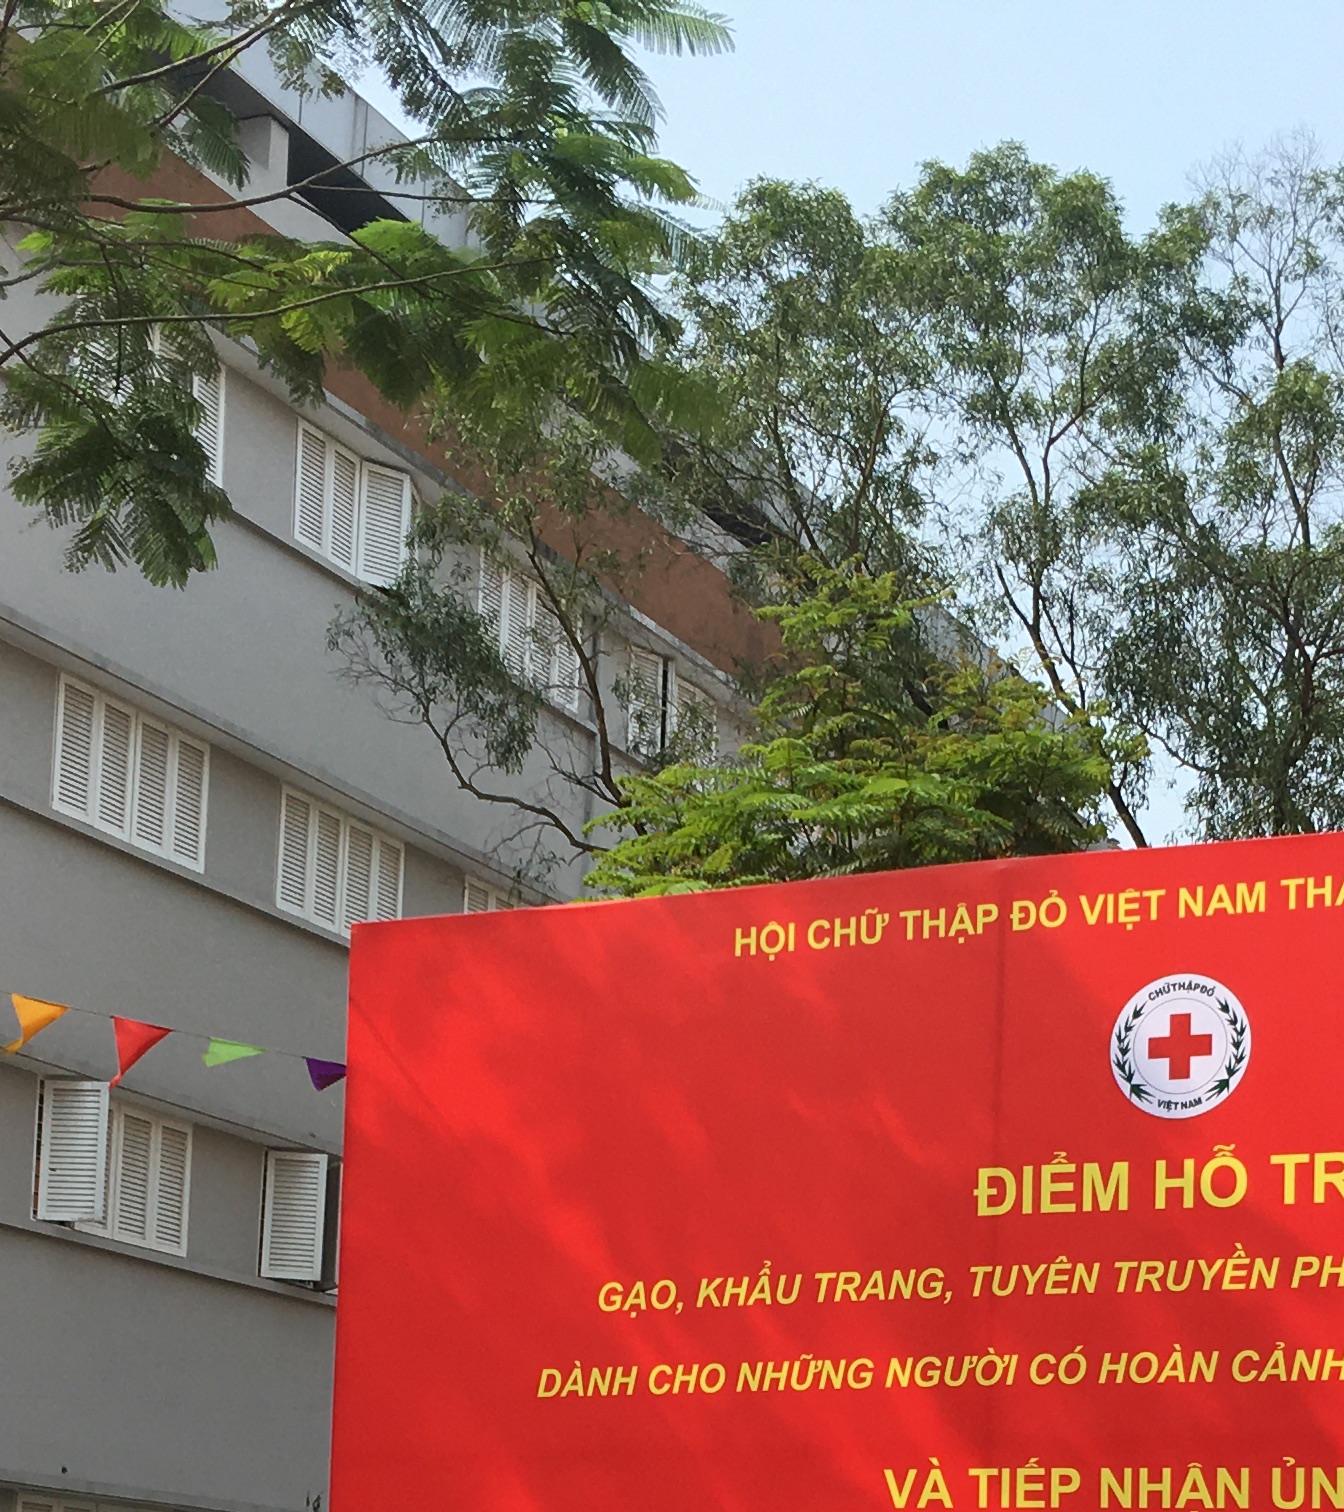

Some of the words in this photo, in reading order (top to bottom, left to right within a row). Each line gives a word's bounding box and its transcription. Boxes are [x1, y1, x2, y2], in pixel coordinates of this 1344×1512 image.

[733, 919, 797, 962] HỘI
[806, 907, 891, 951] CHỮ
[898, 901, 1000, 945] THẬP
[1008, 888, 1069, 932] ĐỎ
[1078, 886, 1168, 932] VIỆT
[1177, 879, 1267, 920] NAM
[1180, 1096, 1203, 1111] NAM
[972, 1150, 1130, 1218] ĐIỂM
[1153, 1142, 1249, 1211] HỖ
[597, 1278, 685, 1320] GẠO,
[695, 1259, 804, 1309] KHẨU
[813, 1266, 954, 1306] TRANG,
[969, 1254, 1102, 1298] TUYÊN
[1113, 1242, 1282, 1294] TRUYỀN
[536, 1359, 639, 1399] DÀNH
[647, 1361, 727, 1396] CHO
[735, 1352, 876, 1394] NHỮNG
[884, 1346, 1020, 1389] NGƯỜI
[1028, 1344, 1088, 1386] CÓ
[1097, 1342, 1220, 1385] HOÀN
[882, 1456, 955, 1510] VÀ
[967, 1456, 1082, 1510] TIẾP
